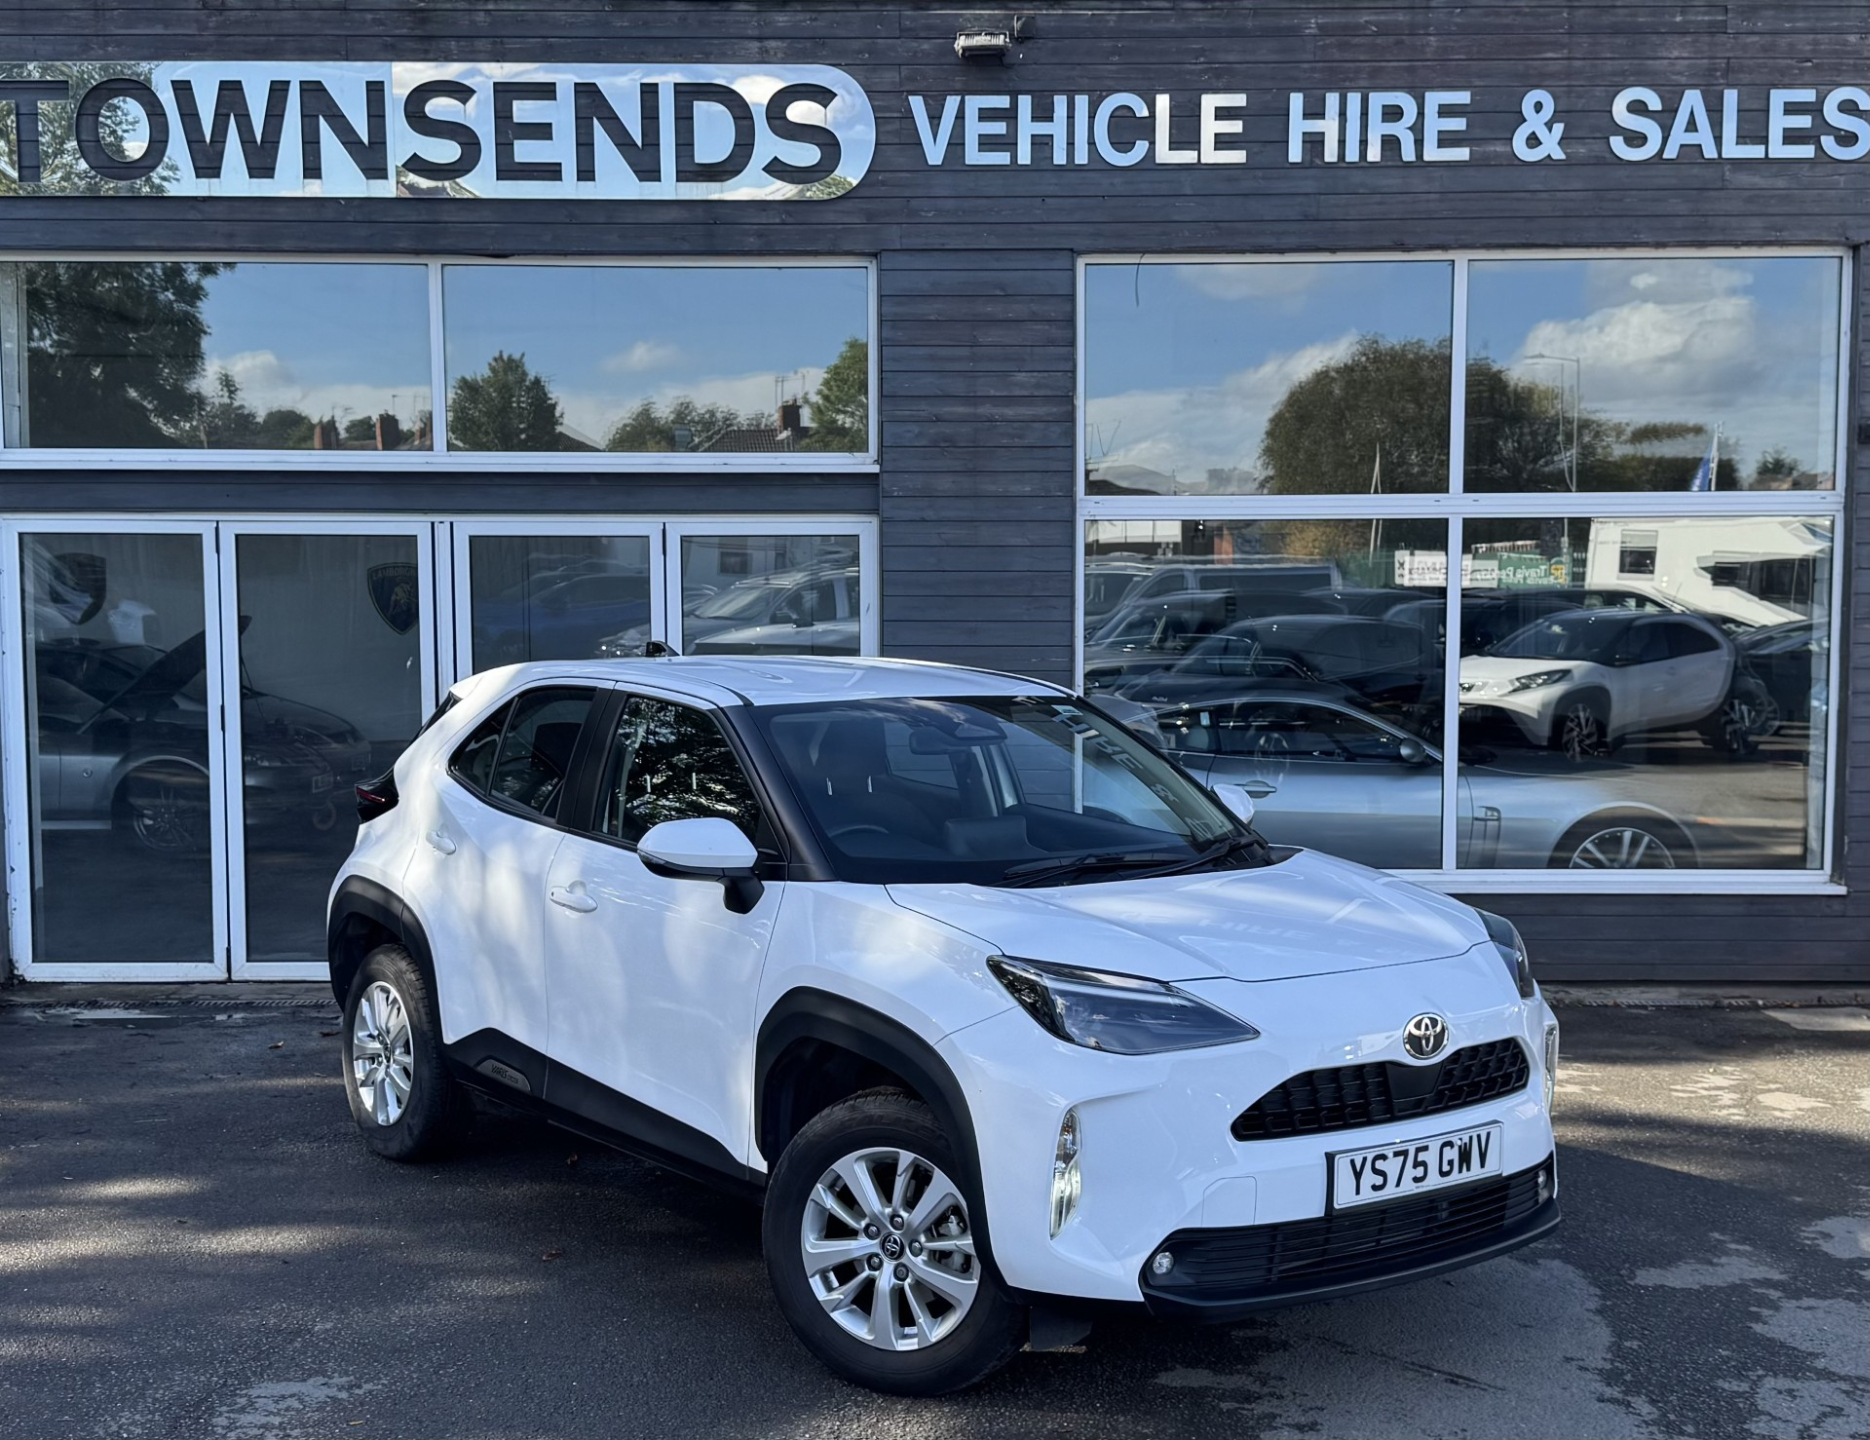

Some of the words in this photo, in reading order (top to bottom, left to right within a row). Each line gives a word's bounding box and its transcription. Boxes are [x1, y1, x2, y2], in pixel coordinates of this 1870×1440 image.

[0, 77, 842, 184] TOWNSENDS
[908, 92, 1247, 167] VEHICLE
[1288, 90, 1471, 163] HIRE
[1512, 88, 1566, 162] &
[1609, 86, 1870, 162] SALES
[372, 566, 416, 580] LAMBORGH
[1349, 1145, 1430, 1196] YS75
[1438, 1131, 1492, 1178] GWV
